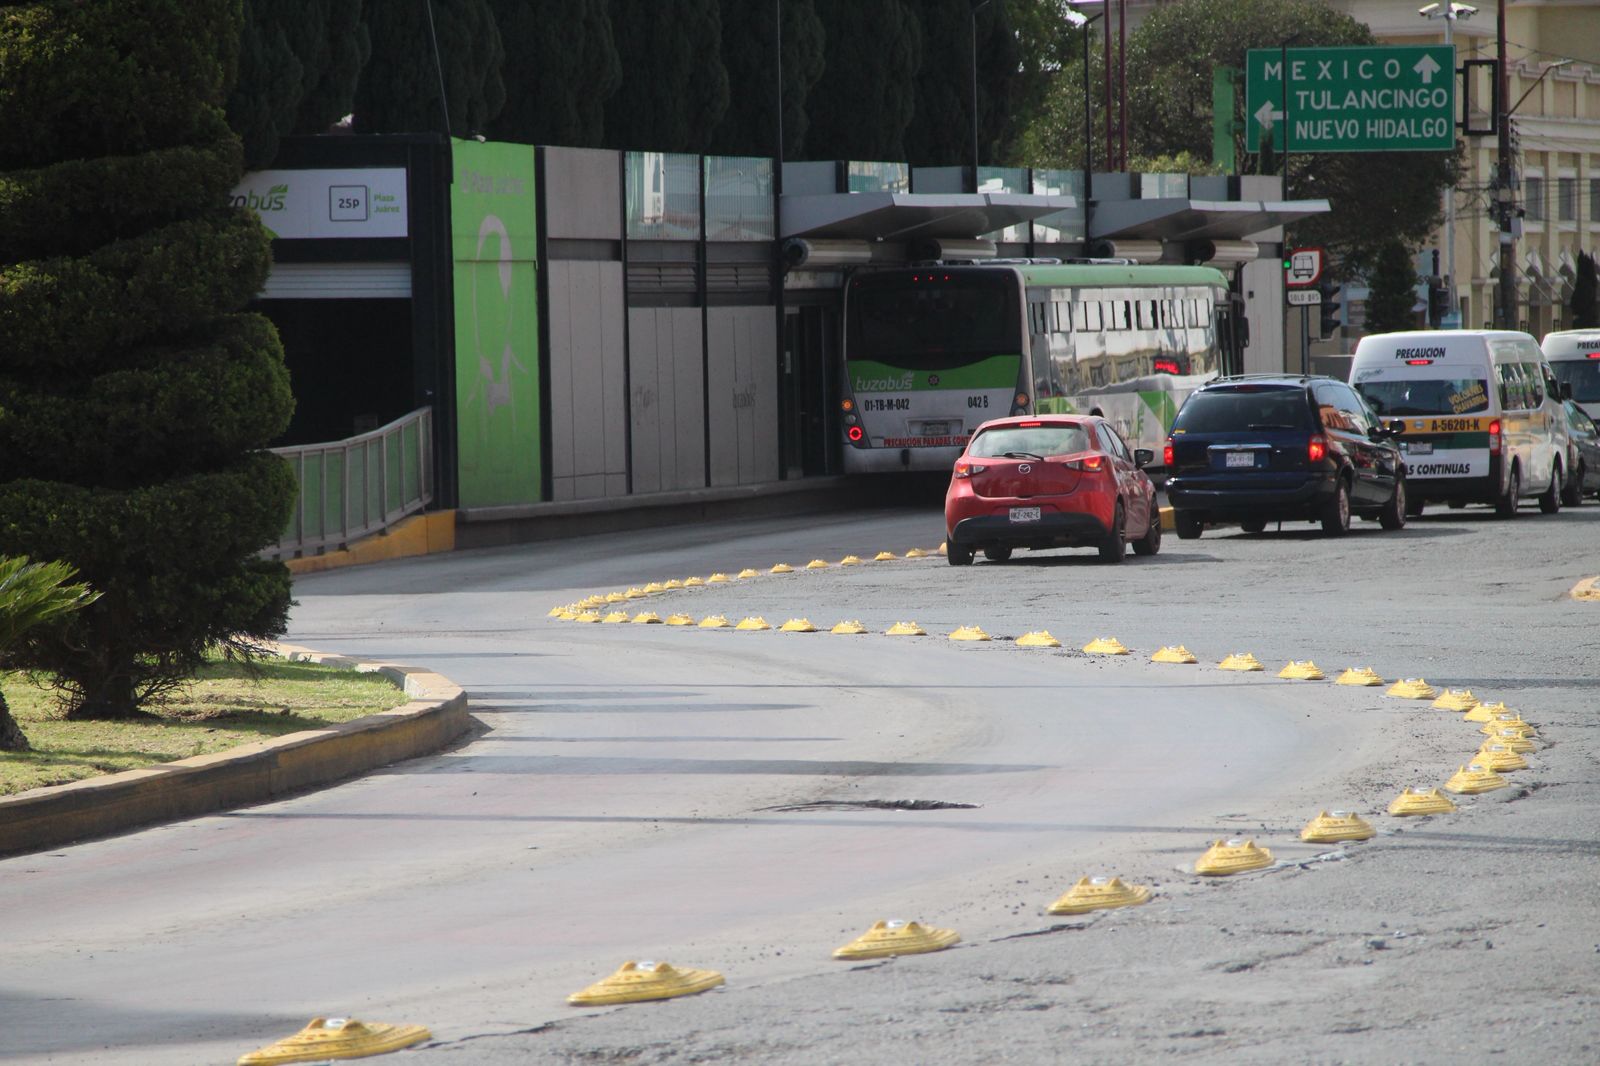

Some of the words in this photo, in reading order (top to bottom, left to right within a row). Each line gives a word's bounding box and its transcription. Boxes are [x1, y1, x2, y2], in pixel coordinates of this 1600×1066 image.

[1264, 59, 1401, 80] MEXICO
[1296, 88, 1448, 110] TULANCINGO
[1296, 119, 1360, 140] NUEVO
[1366, 117, 1447, 139] HIDALGO
[374, 194, 395, 202] Plaza
[1395, 347, 1447, 360] PRECAUCION
[856, 375, 912, 391] tuzobus
[864, 398, 910, 412] 01-TB-M-042
[967, 396, 983, 408] 042
[1417, 463, 1471, 476] CONTINUAS
